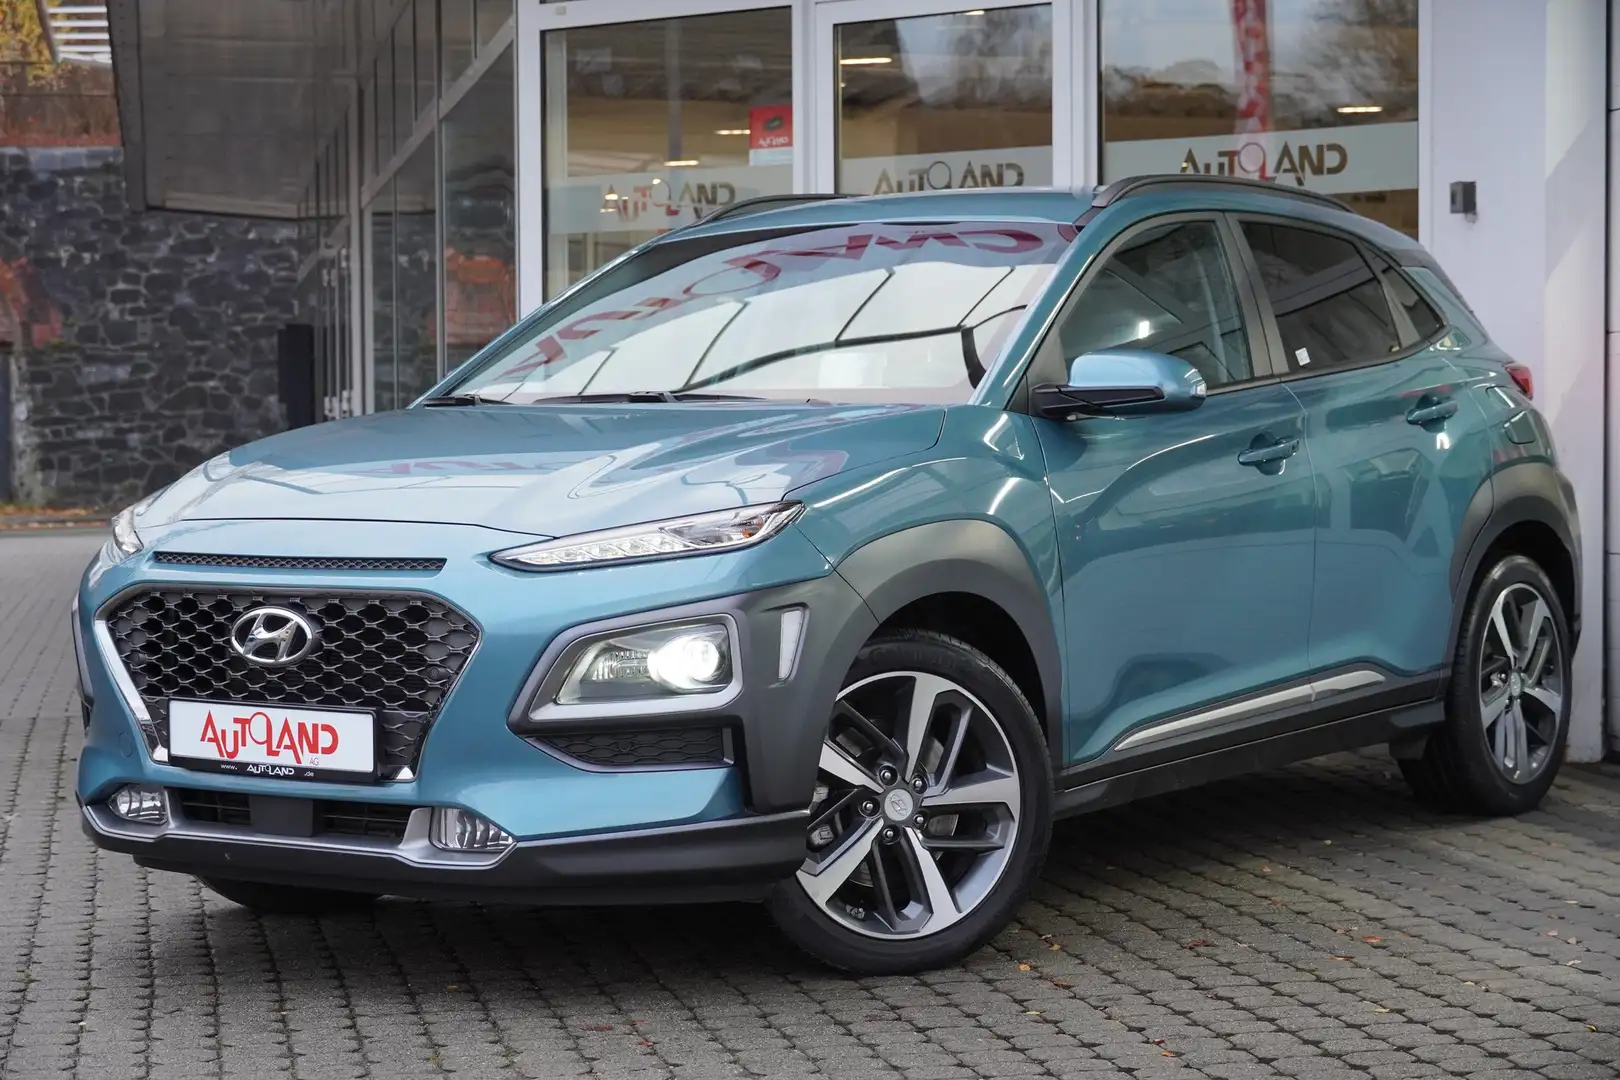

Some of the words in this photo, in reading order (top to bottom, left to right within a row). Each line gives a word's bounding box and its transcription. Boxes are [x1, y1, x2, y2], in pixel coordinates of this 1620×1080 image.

[200, 710, 339, 764] AUTOLAND
[309, 757, 320, 767] AG
[246, 764, 295, 776] AUTOLAND
